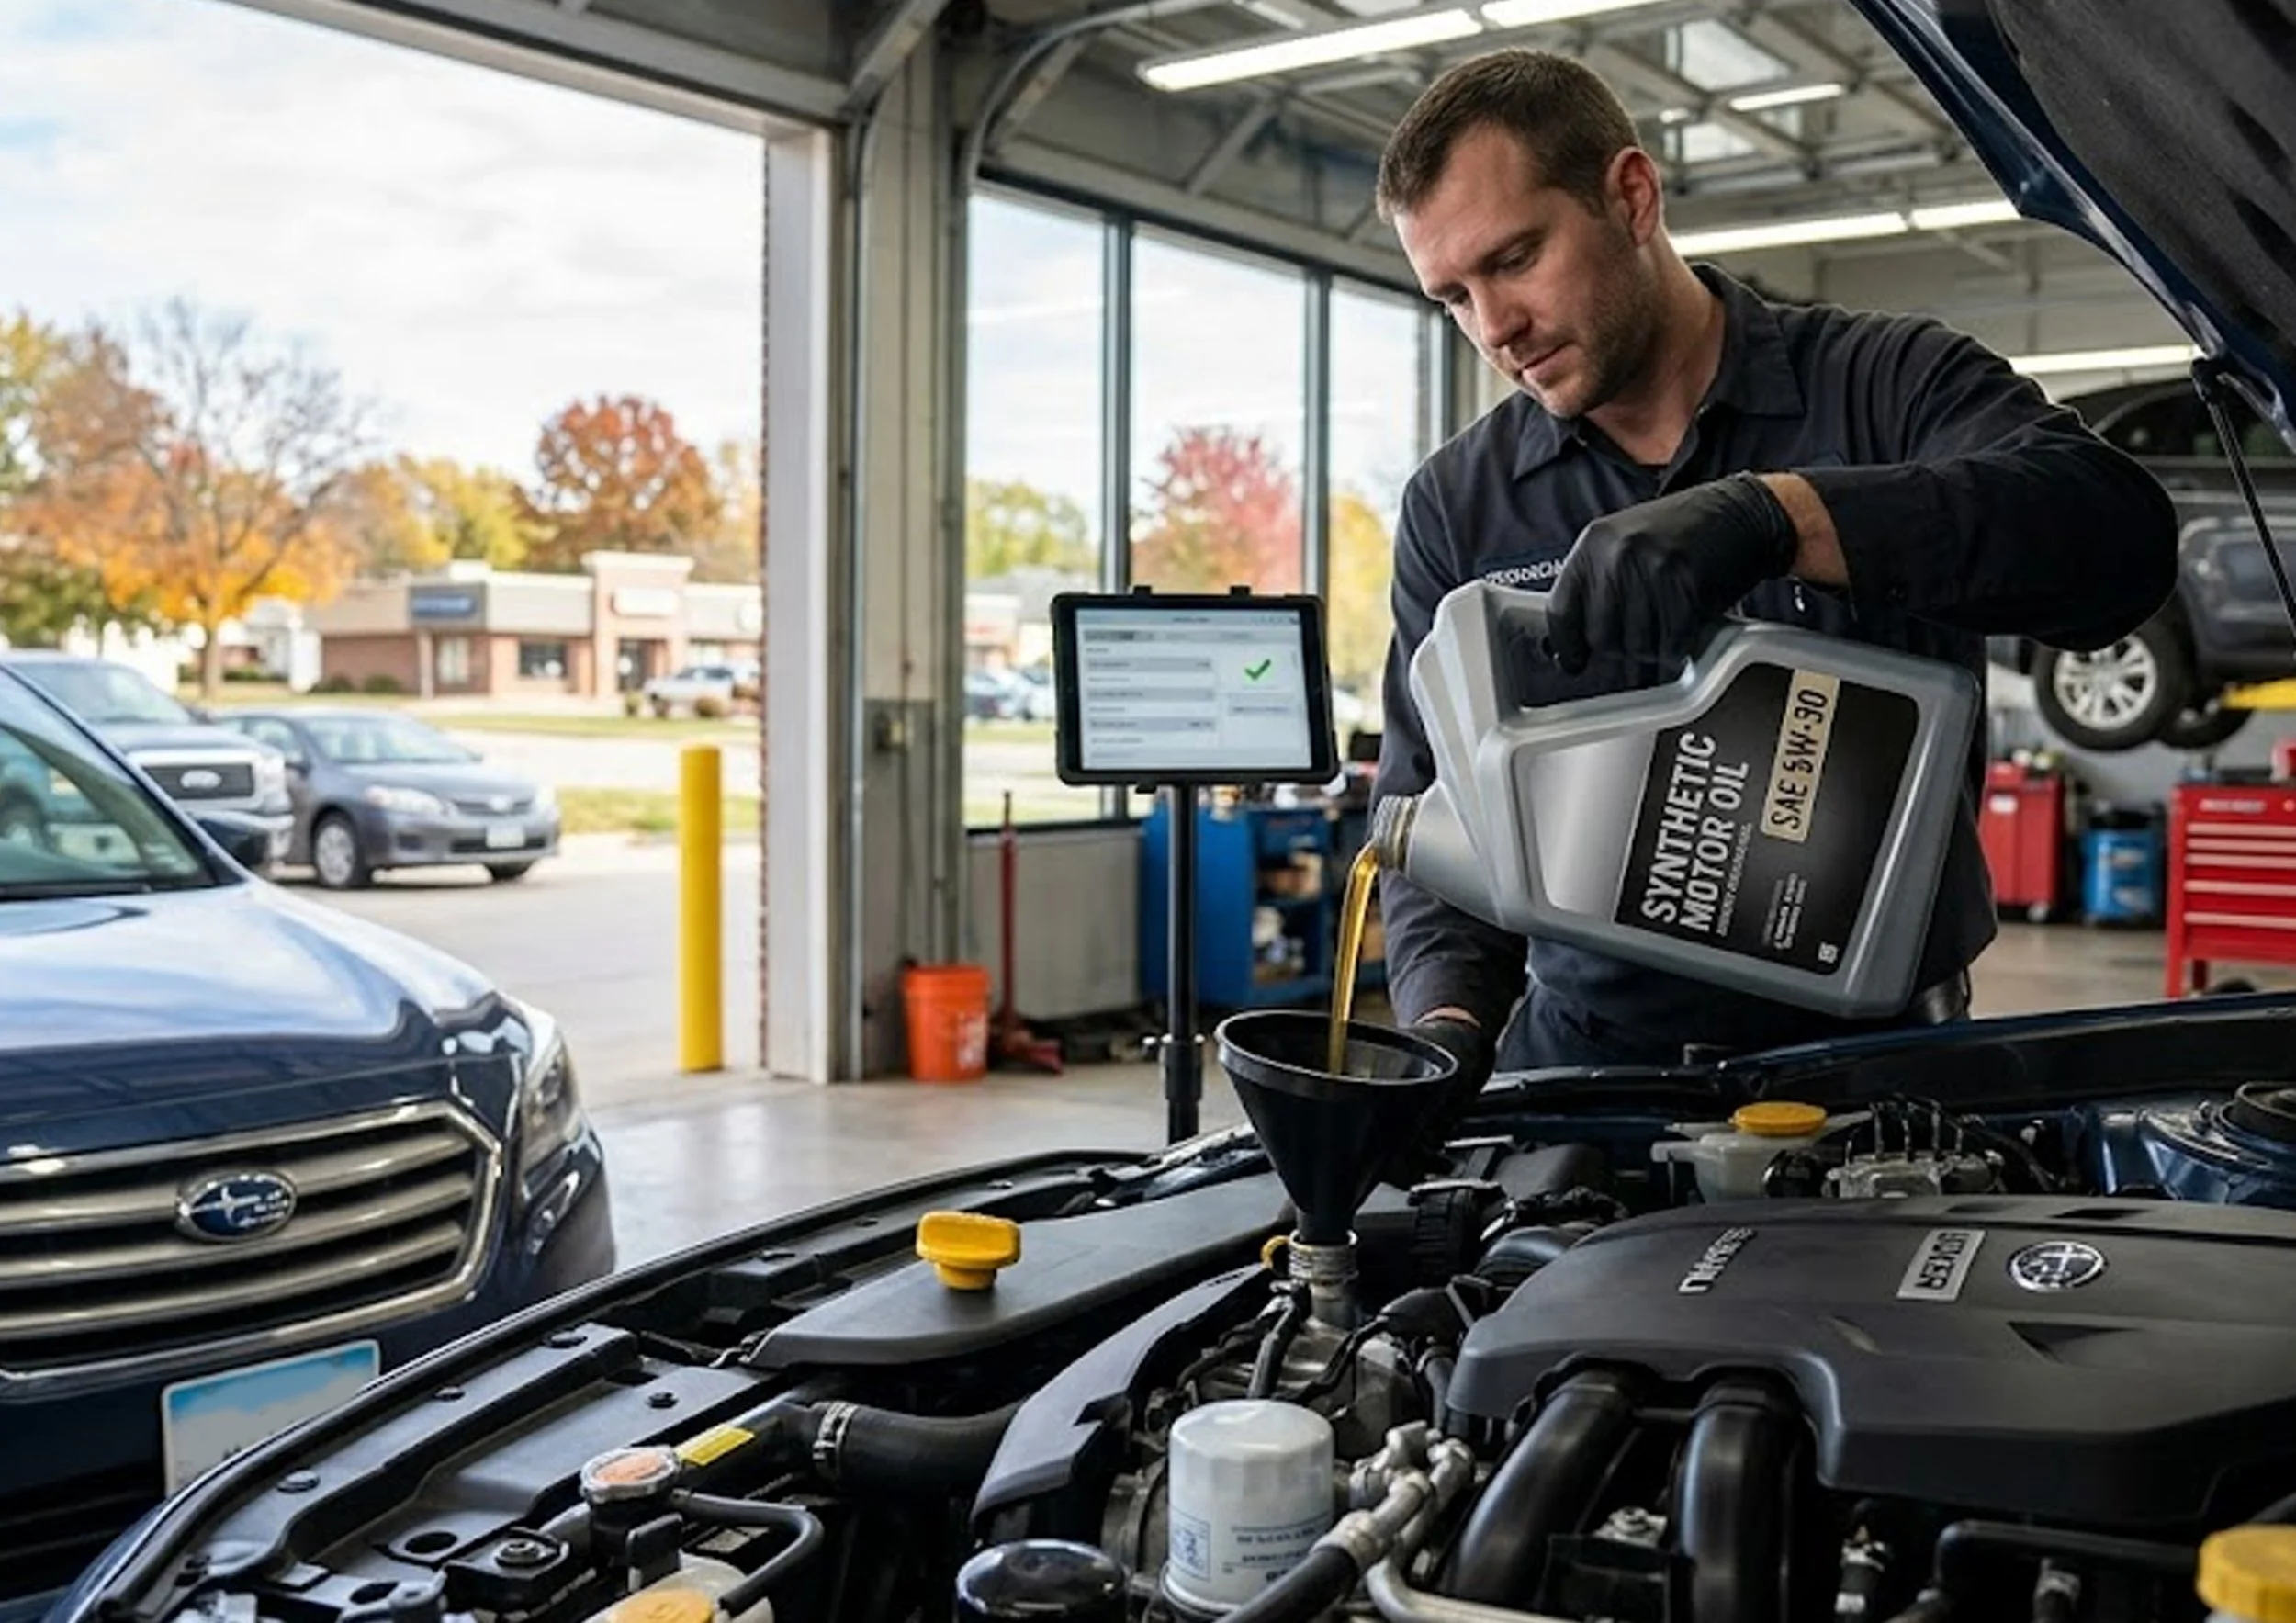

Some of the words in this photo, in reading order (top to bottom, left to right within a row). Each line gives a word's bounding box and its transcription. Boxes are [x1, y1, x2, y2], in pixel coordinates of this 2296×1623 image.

[1640, 732, 1716, 924] SYNTHETIC
[1679, 816, 1735, 932] MOTOR
[1708, 761, 1750, 811] OIL
[1771, 779, 1808, 829] SAE
